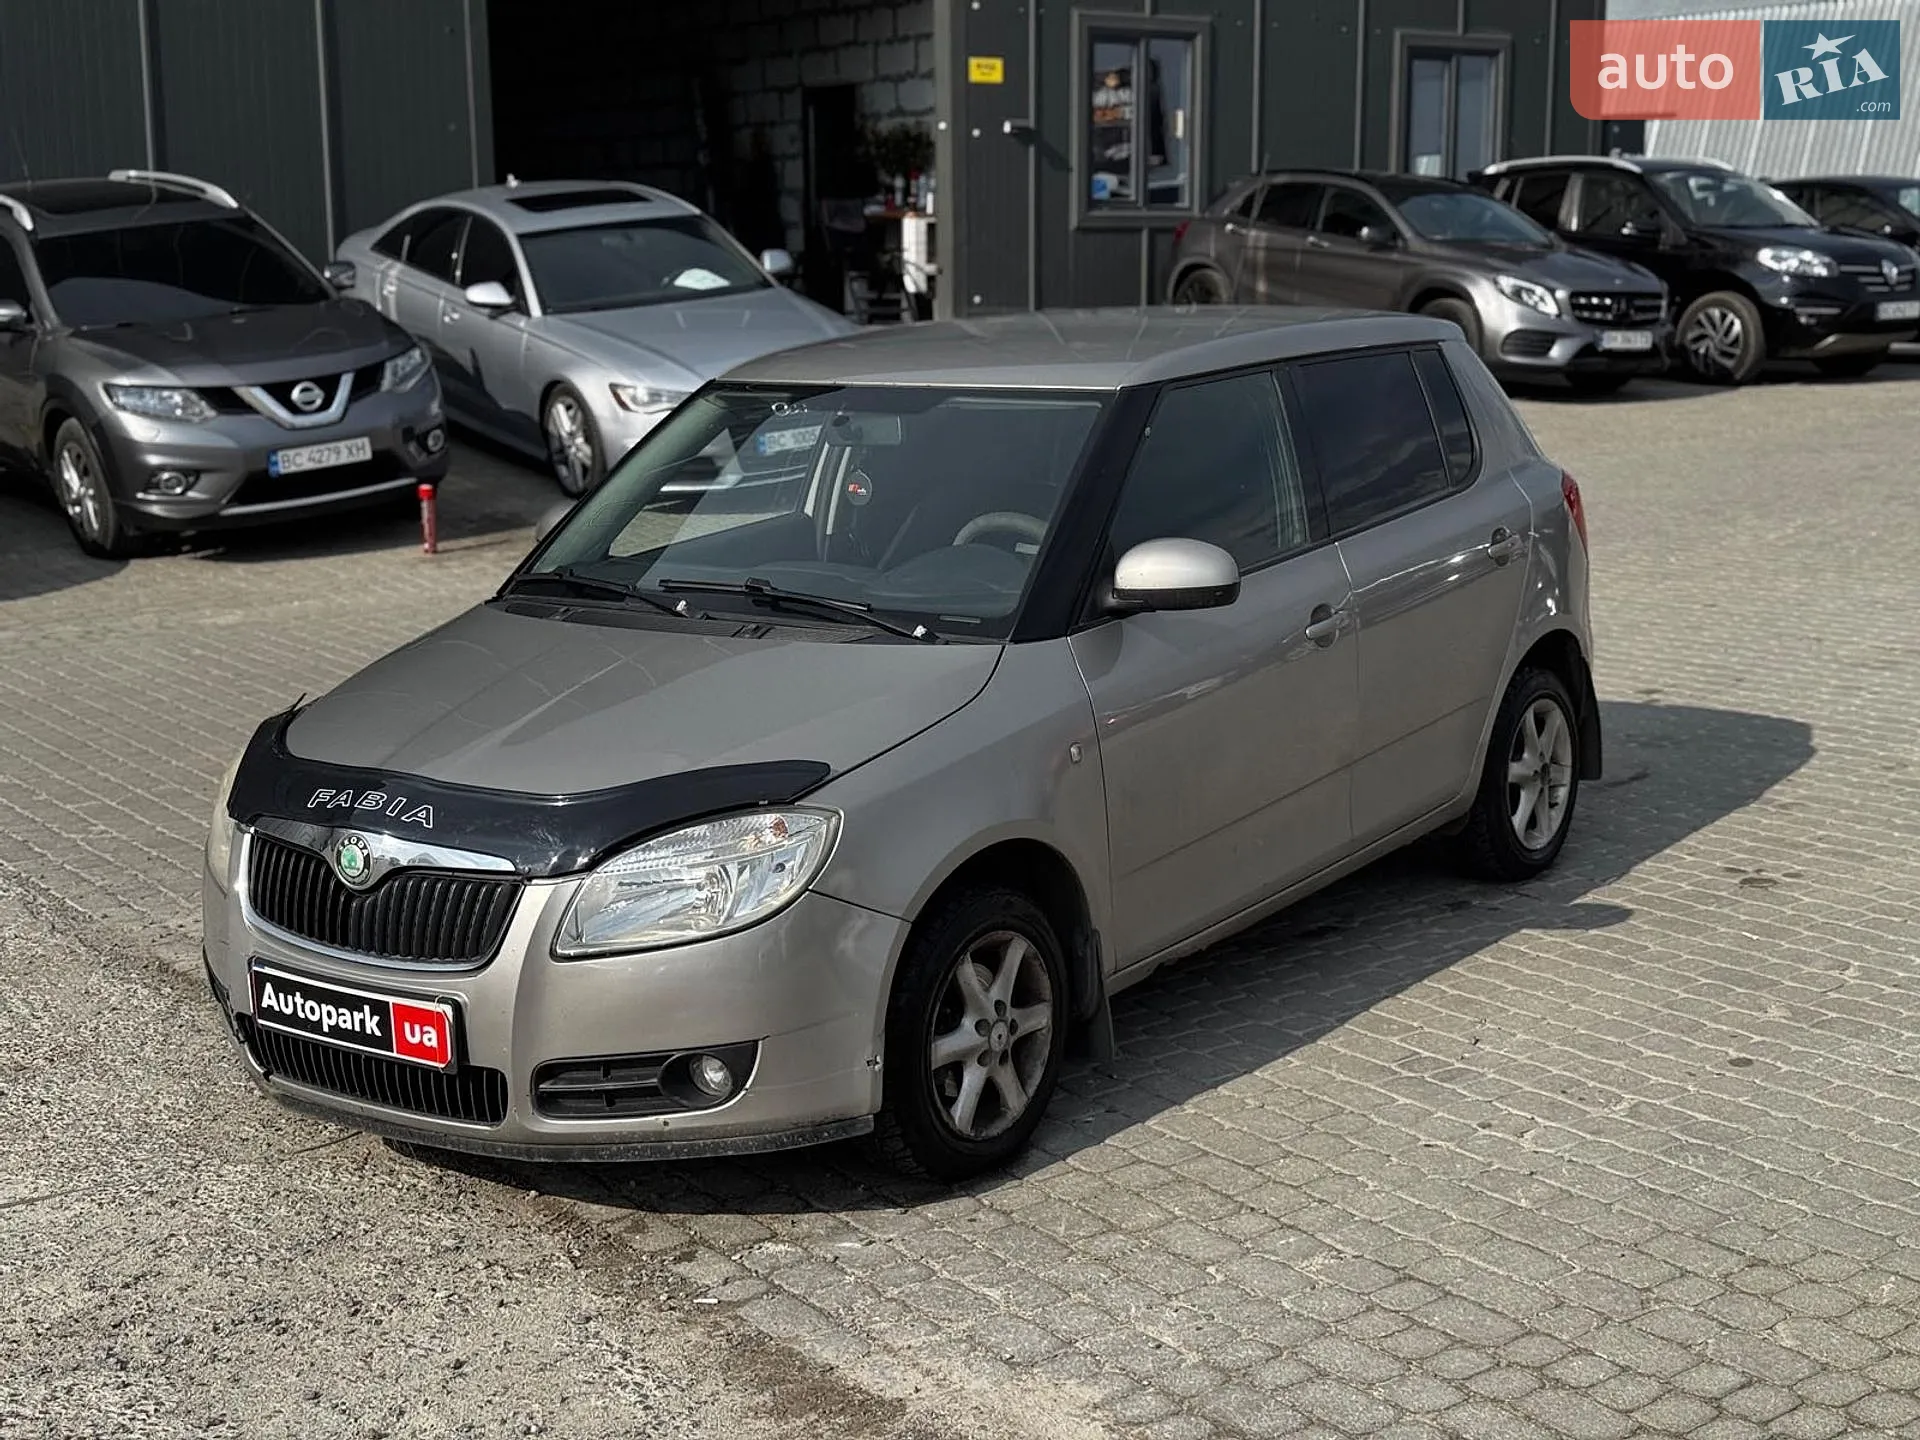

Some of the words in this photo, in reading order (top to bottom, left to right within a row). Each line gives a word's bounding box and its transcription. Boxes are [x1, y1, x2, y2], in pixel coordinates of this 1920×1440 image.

[281, 452, 304, 470] BC
[307, 446, 341, 464] 4279
[345, 441, 366, 459] XH
[307, 788, 434, 829] FABIA
[261, 982, 382, 1037] Autopark
[403, 1021, 438, 1048] ua
